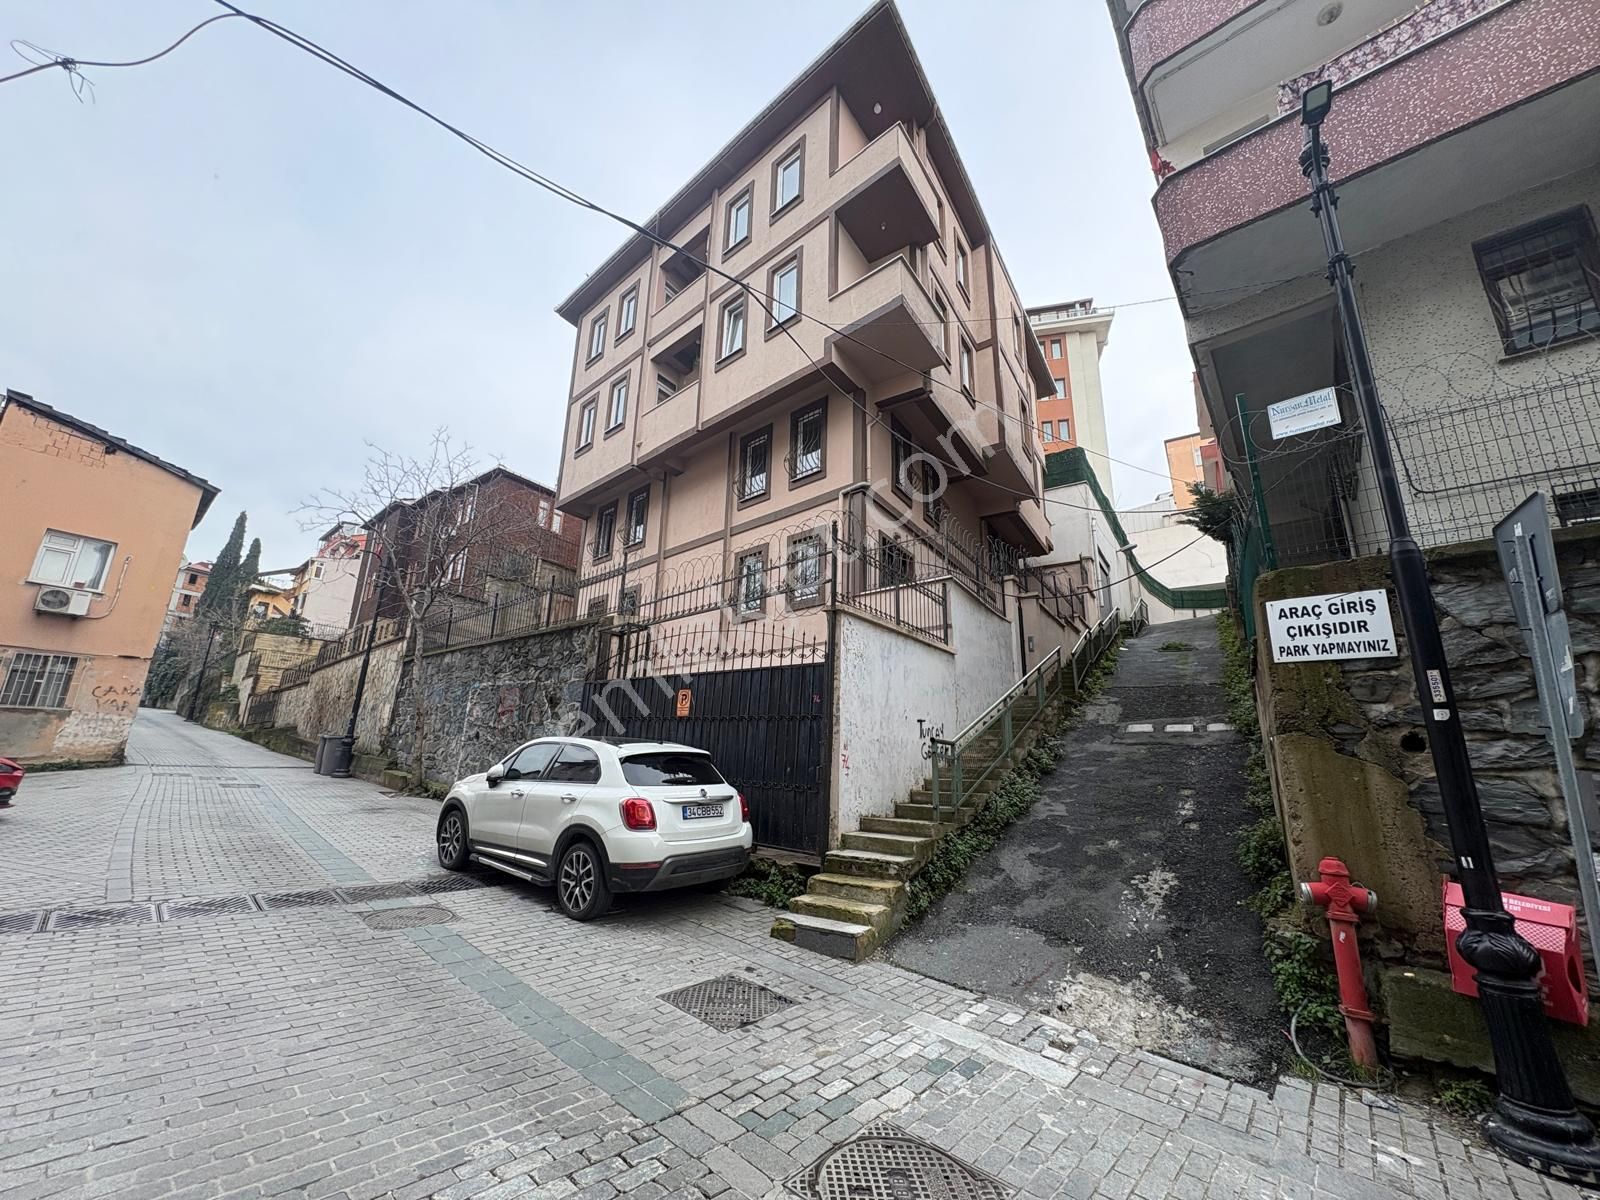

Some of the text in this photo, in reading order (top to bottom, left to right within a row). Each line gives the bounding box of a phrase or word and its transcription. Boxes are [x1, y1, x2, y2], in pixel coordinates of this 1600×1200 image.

[1303, 390, 1333, 408] Metal
[1278, 597, 1376, 620] ARAÇ GİRİŞ
[1286, 620, 1369, 641] ÇIKIŞIDIR
[1279, 639, 1390, 657] PARK YAPMAYINIZ
